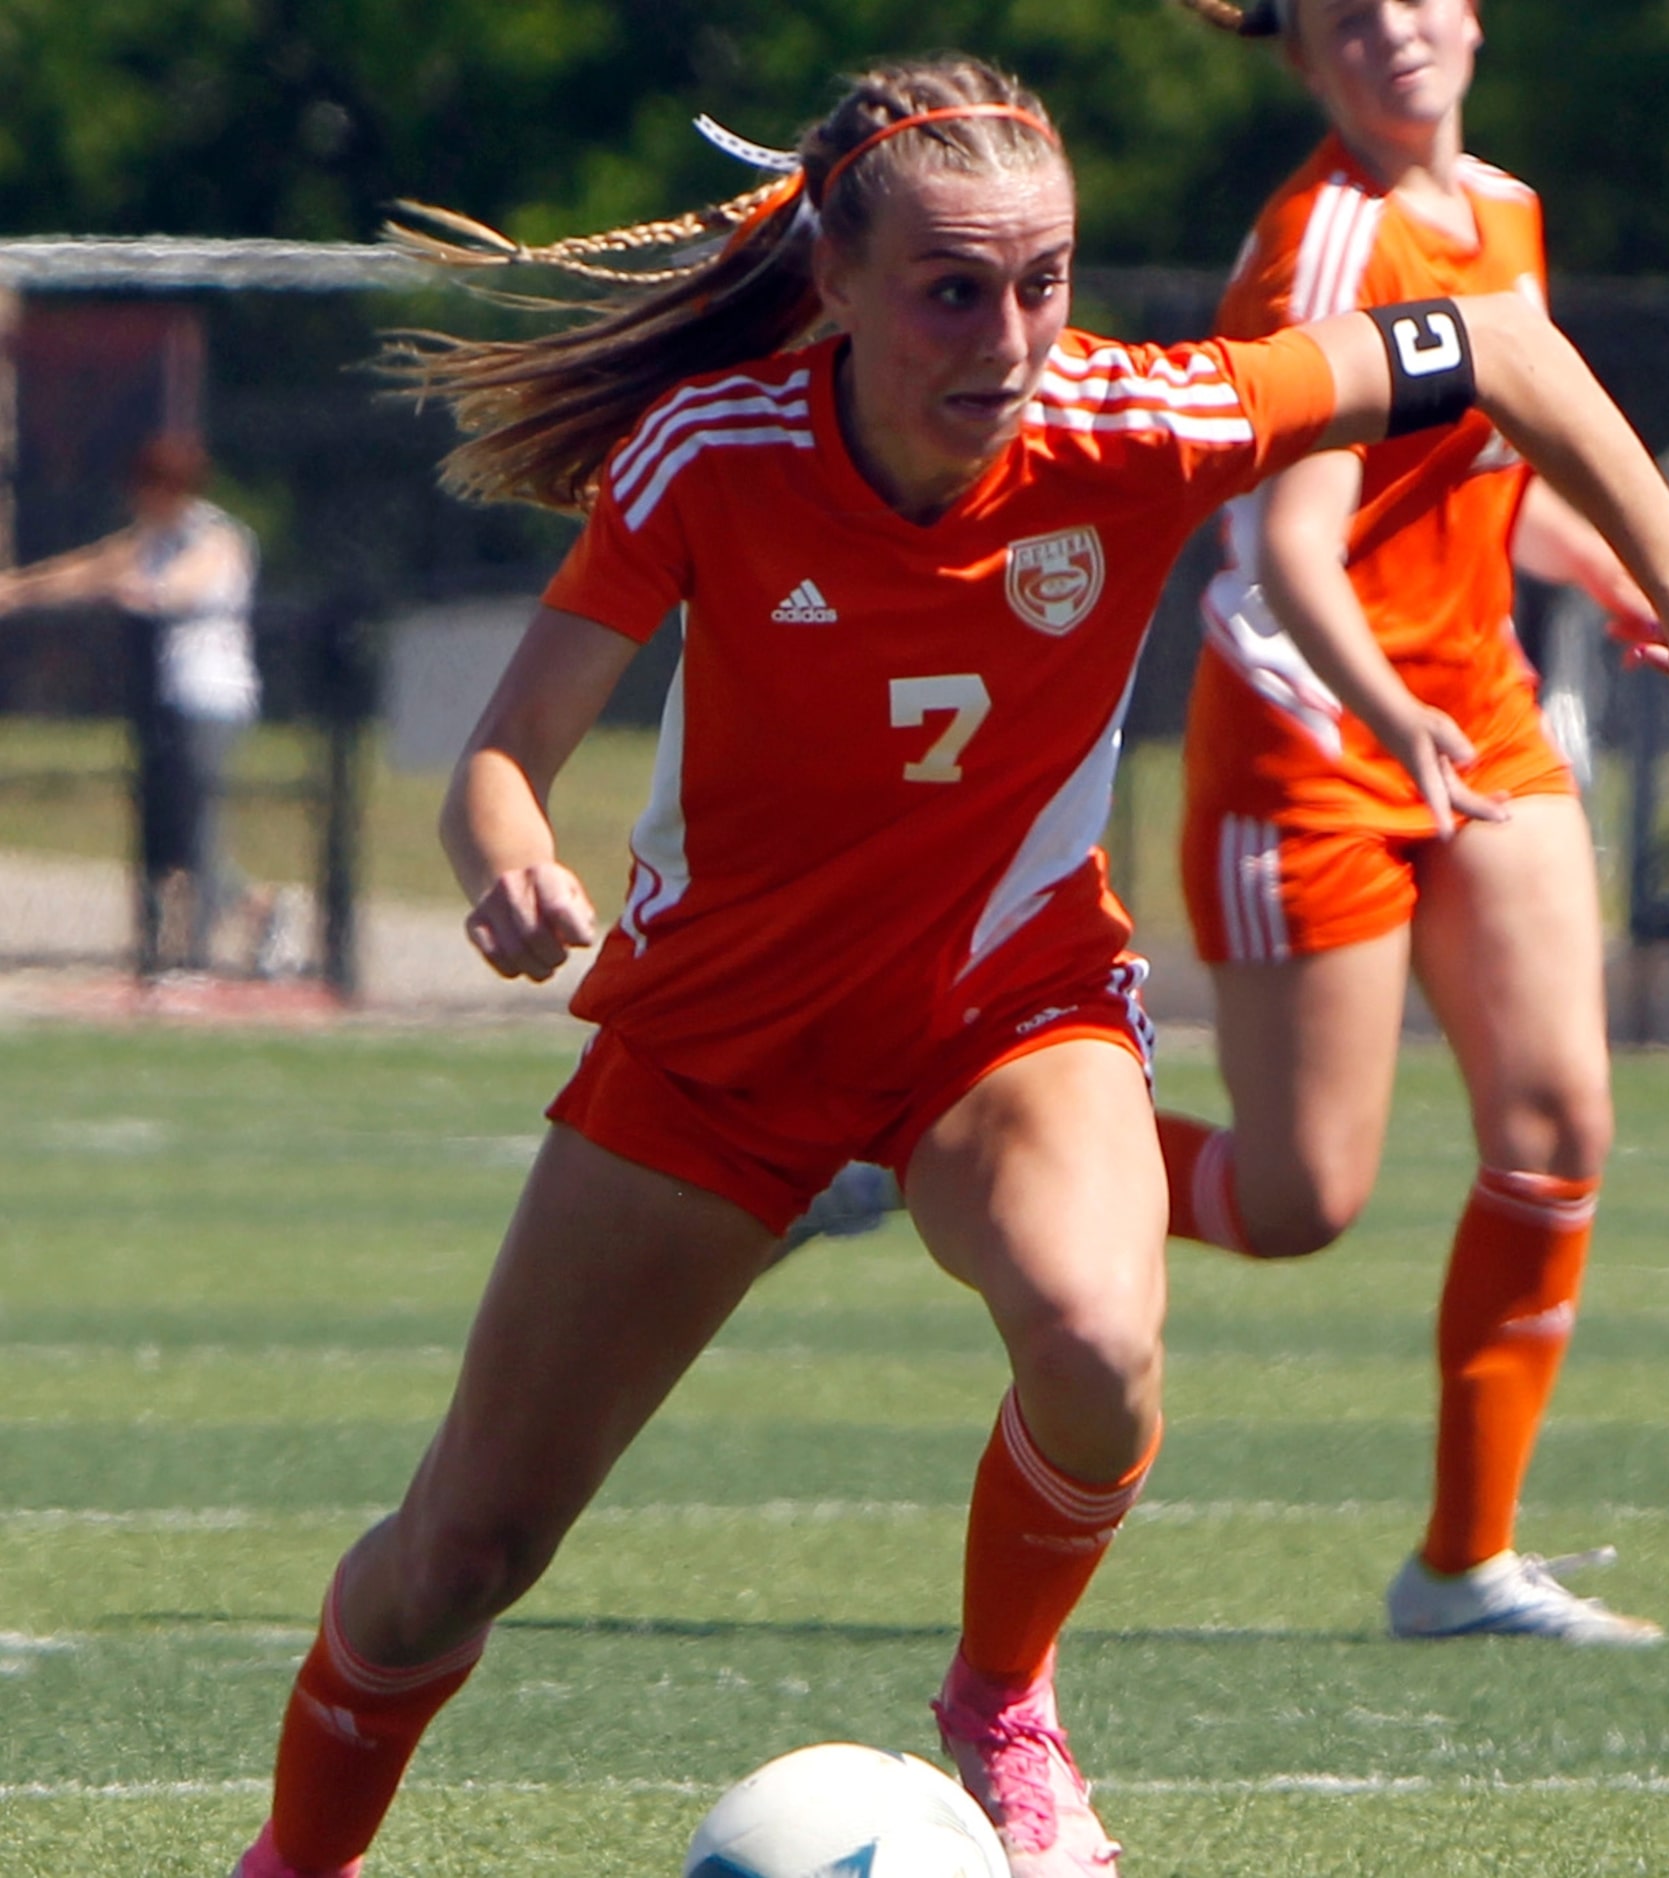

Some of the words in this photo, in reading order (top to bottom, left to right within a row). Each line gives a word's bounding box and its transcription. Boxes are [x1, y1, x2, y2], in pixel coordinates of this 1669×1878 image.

[1393, 312, 1462, 377] C
[770, 607, 838, 624] adidas
[889, 673, 992, 784] 7
